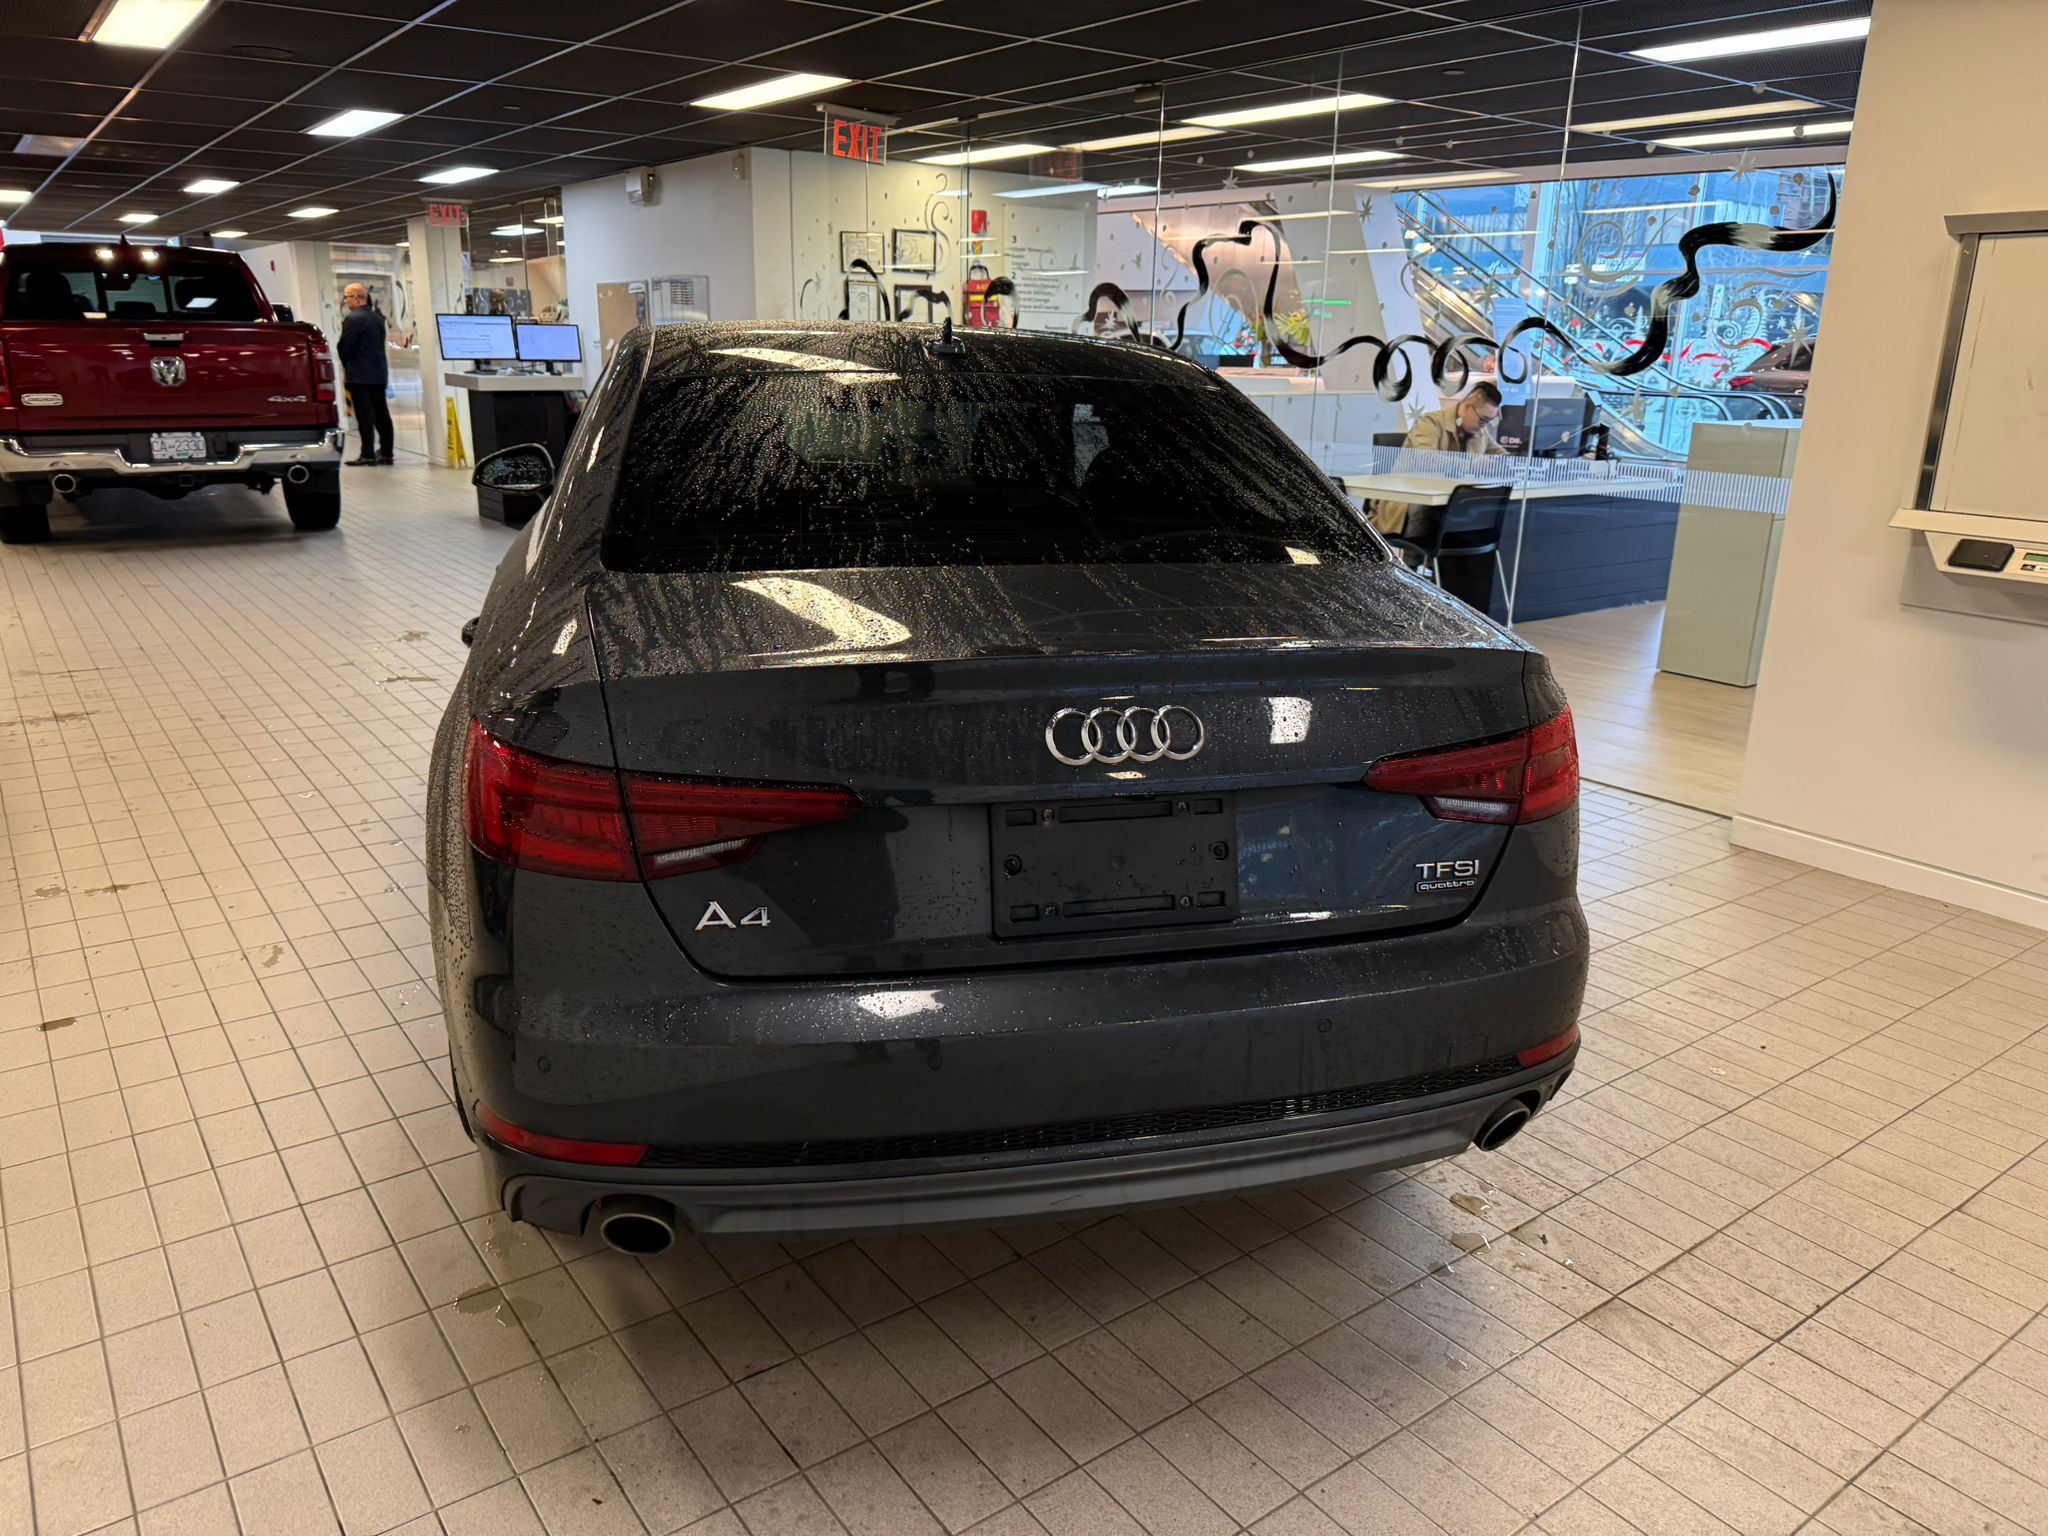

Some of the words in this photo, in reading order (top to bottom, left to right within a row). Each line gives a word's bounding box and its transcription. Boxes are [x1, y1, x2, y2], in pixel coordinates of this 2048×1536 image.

[833, 119, 882, 163] EXIT
[430, 203, 463, 225] EXIT
[1011, 235, 1017, 244] 3
[1011, 272, 1017, 280] 2
[1415, 859, 1480, 879] TFSI
[1420, 880, 1475, 891] quattro
[694, 900, 771, 931] A4
